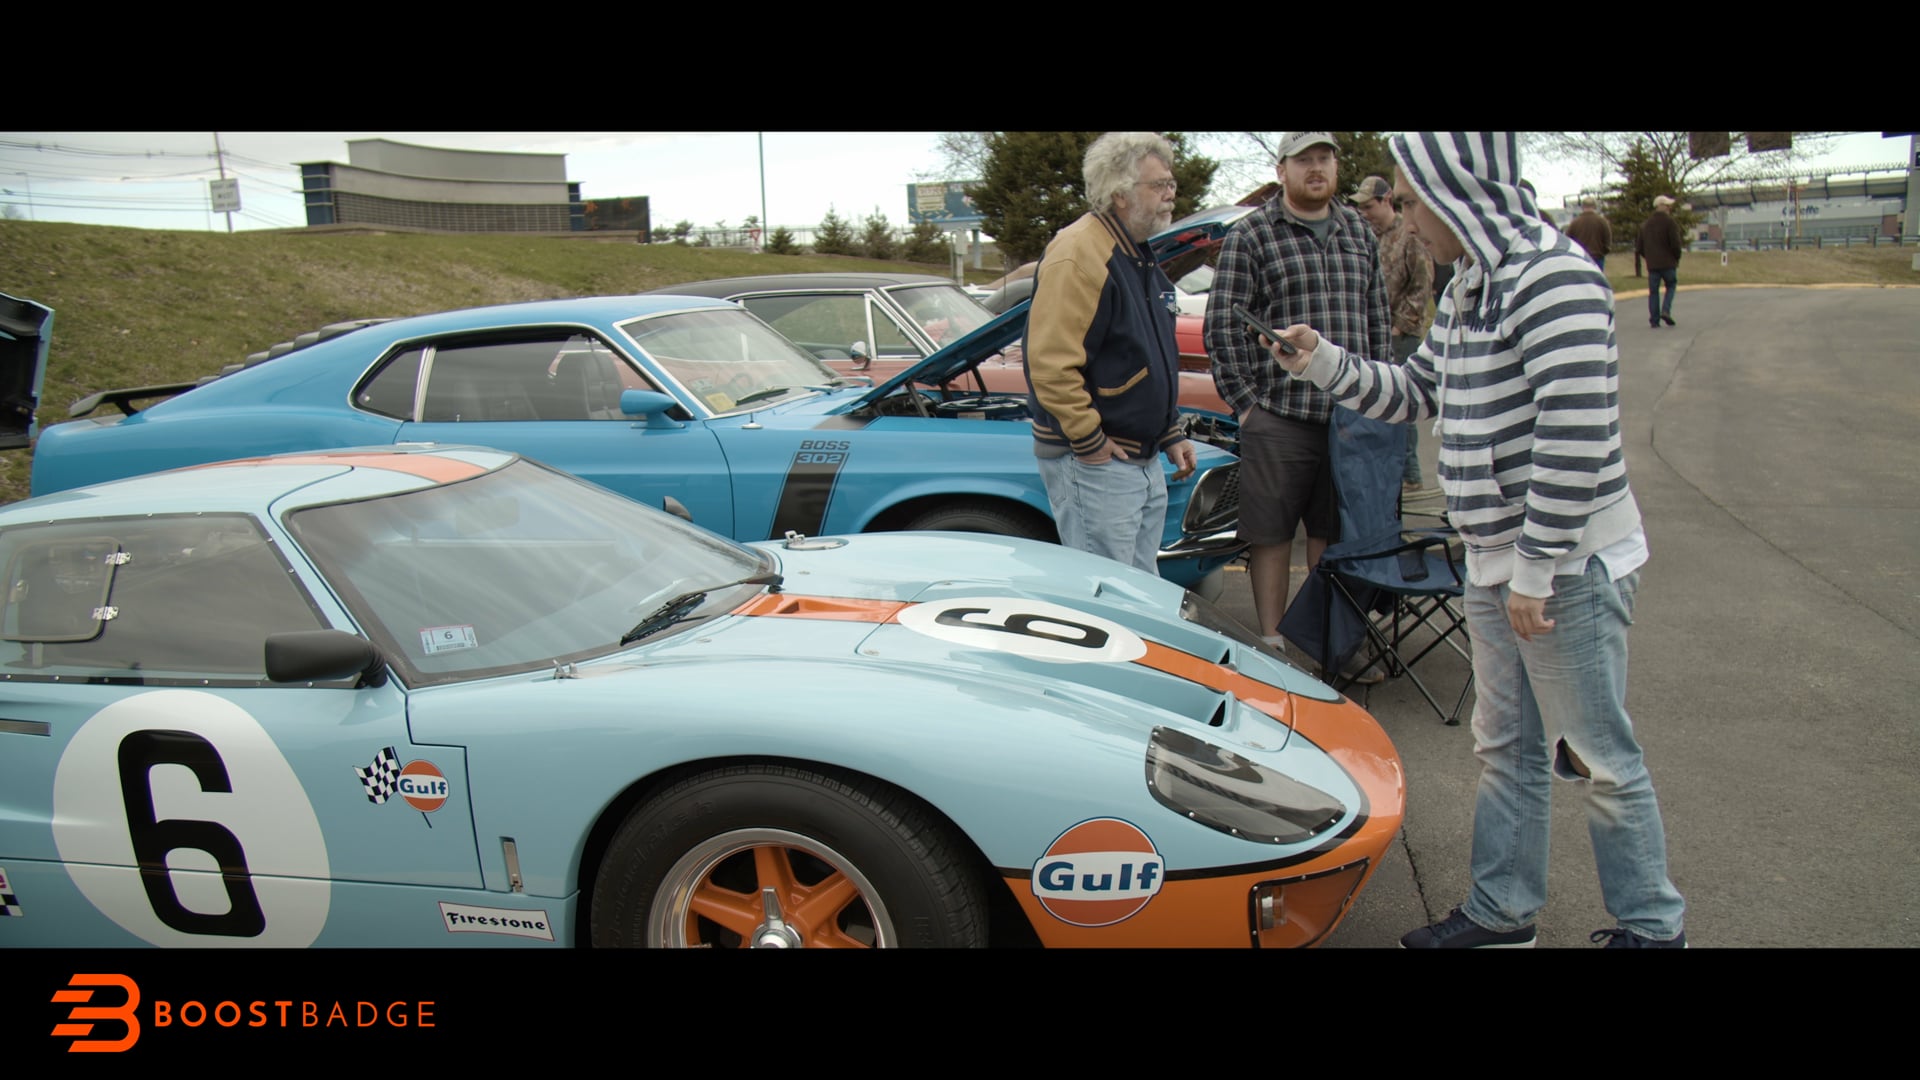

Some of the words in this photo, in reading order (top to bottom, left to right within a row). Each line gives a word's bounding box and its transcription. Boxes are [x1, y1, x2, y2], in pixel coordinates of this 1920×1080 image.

[799, 440, 851, 450] BOSS
[796, 453, 843, 464] 302
[443, 631, 454, 640] 6
[934, 607, 1110, 649] 6
[399, 778, 447, 795] Gulf
[117, 729, 267, 938] 6
[1038, 861, 1160, 891] Gulf
[446, 911, 546, 930] Firestone
